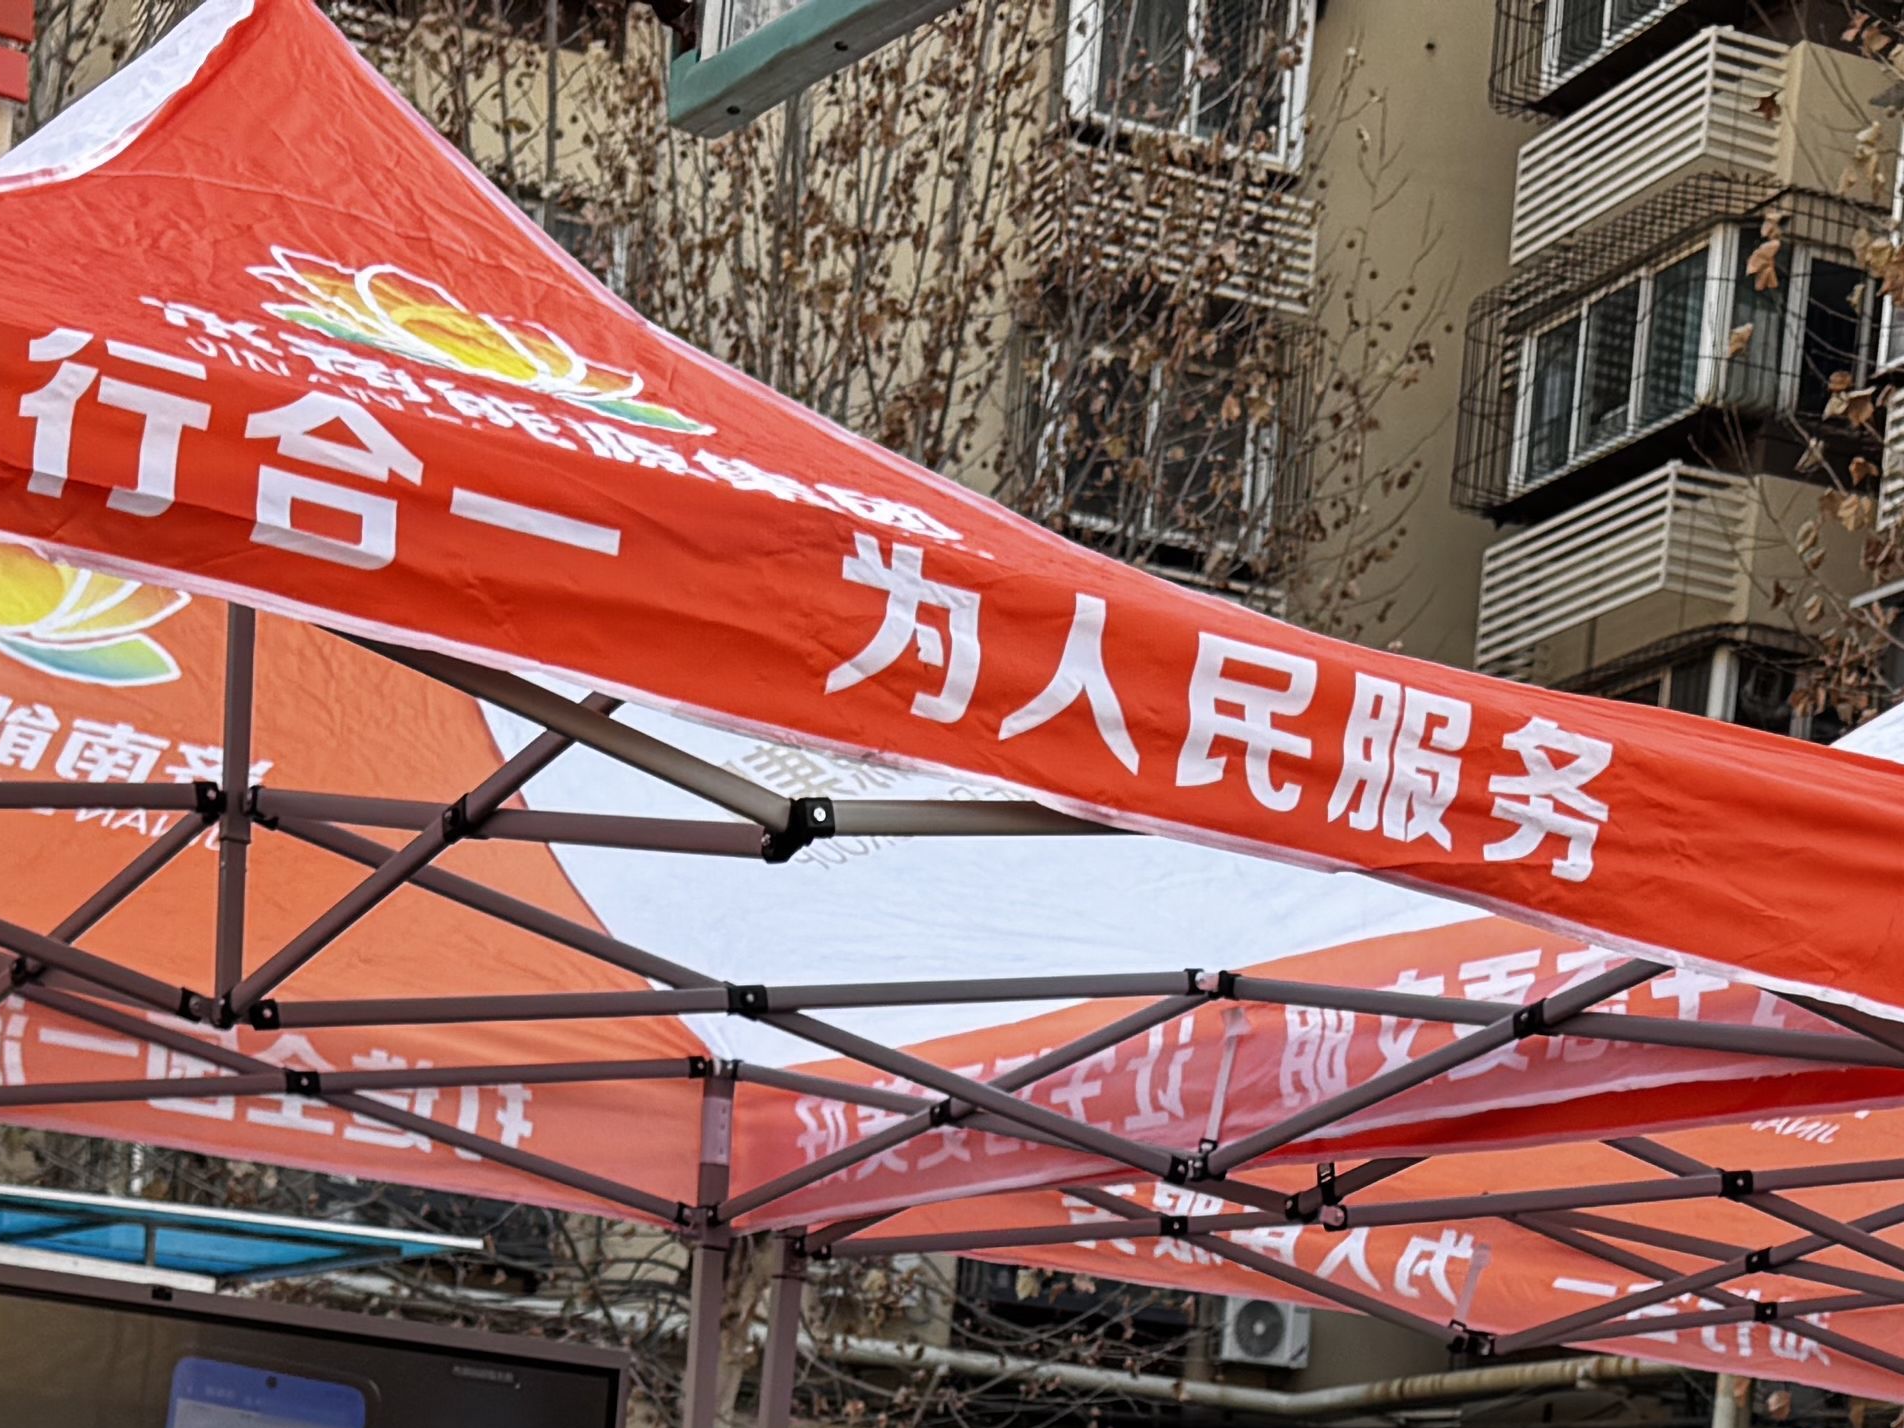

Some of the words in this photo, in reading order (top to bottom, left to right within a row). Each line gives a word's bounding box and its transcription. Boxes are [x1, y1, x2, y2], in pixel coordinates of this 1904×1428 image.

[826, 532, 1614, 882] 为人民服务
